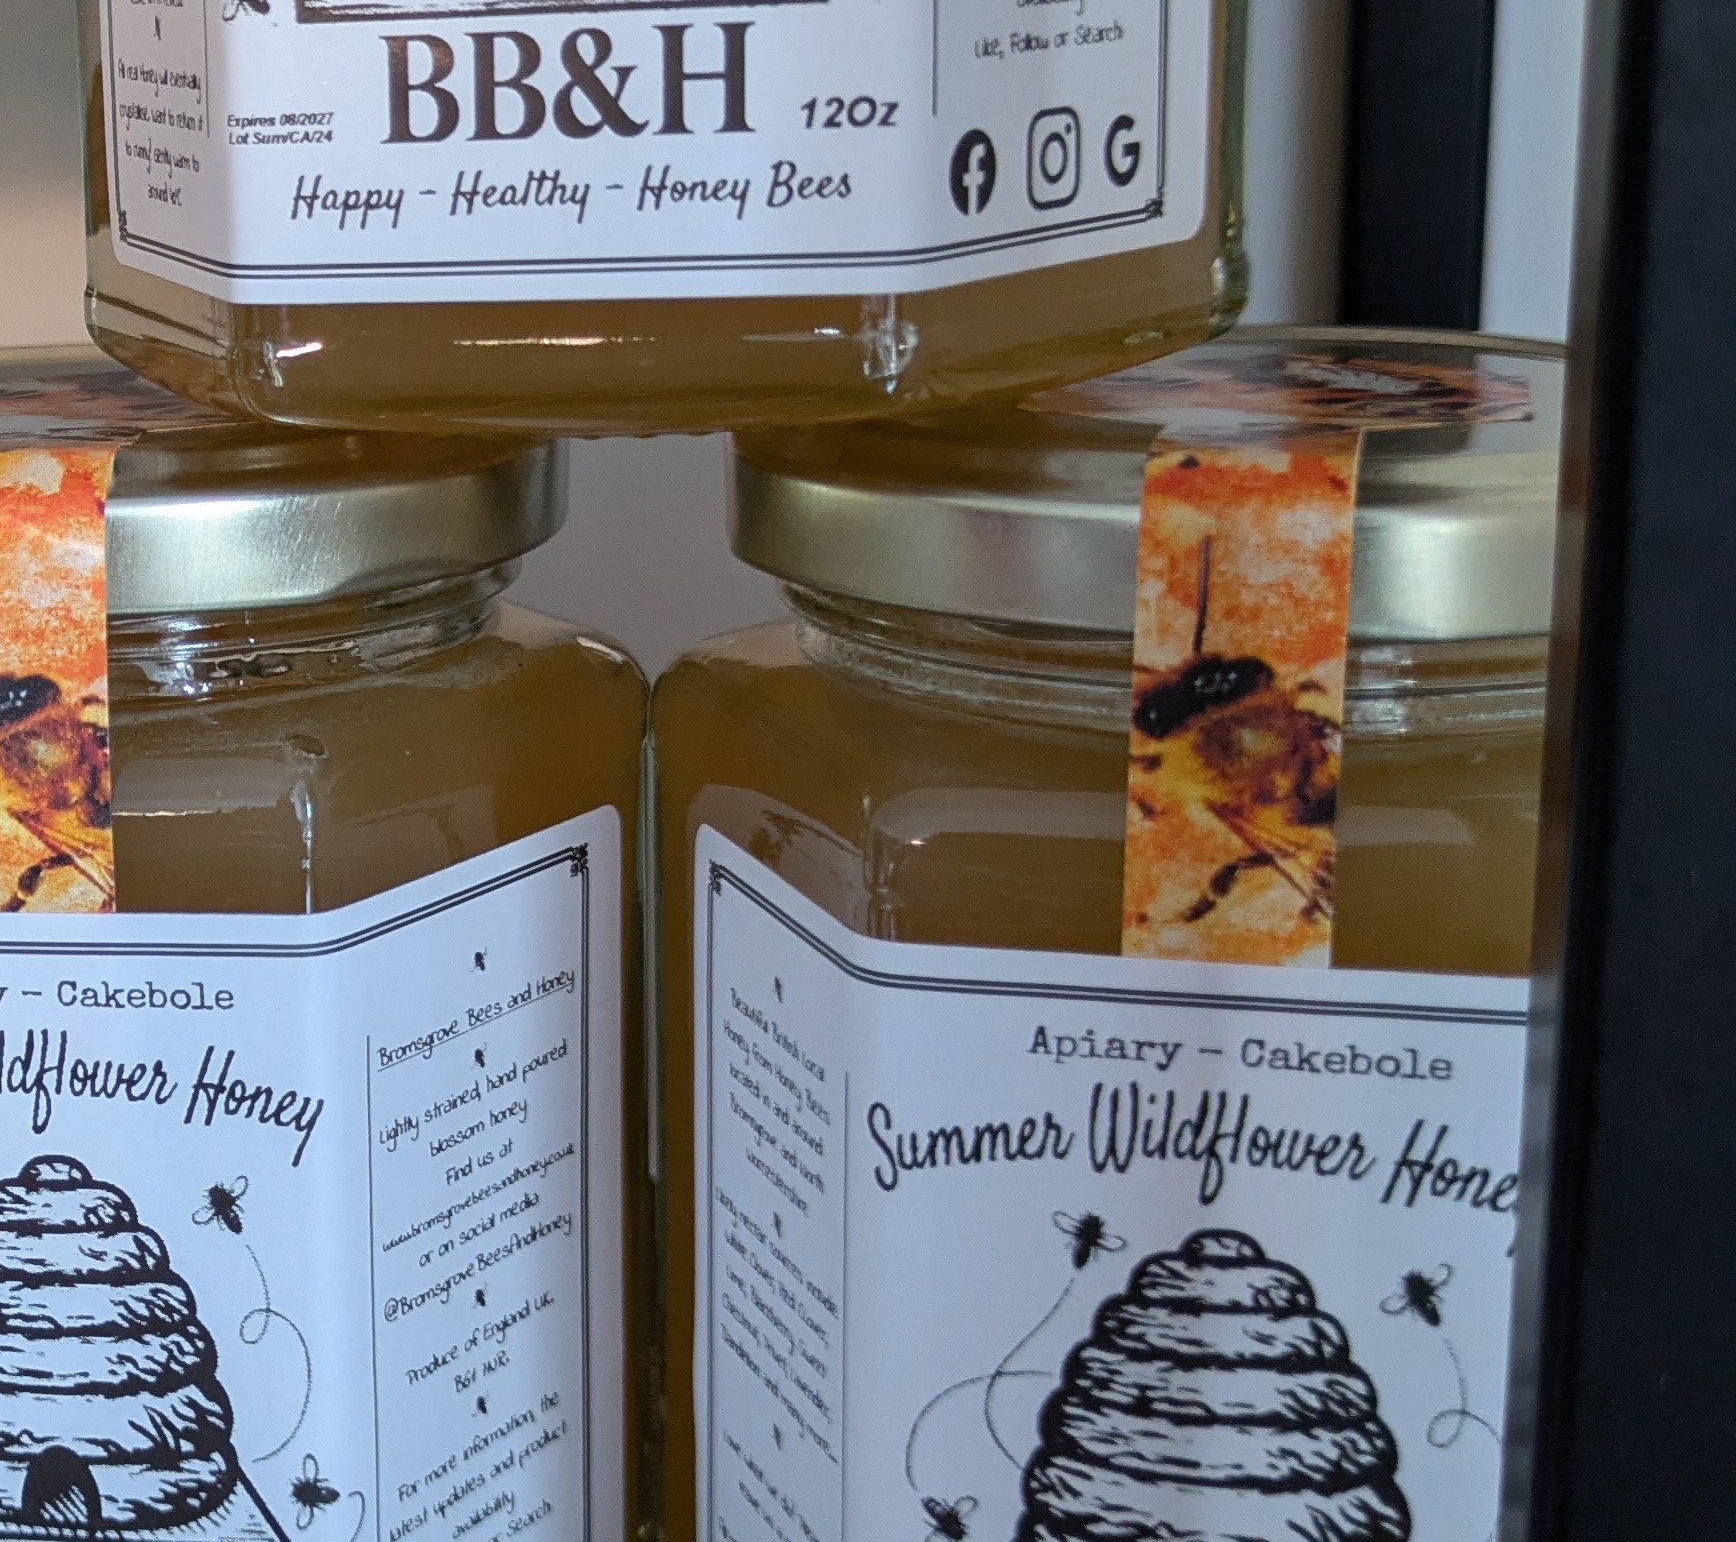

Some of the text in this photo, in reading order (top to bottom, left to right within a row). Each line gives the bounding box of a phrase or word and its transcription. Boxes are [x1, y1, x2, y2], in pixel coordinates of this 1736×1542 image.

[1009, 32, 1050, 53] Follow
[1054, 31, 1069, 48] or
[1074, 19, 1124, 46] Search
[378, 21, 756, 144] BB&H
[227, 111, 334, 130] Expires 08/2027
[228, 132, 249, 145] Lot
[290, 173, 405, 231] Happy
[449, 170, 589, 224] Healthy
[636, 164, 751, 219] Honey
[766, 160, 854, 208] Bees
[56, 980, 235, 1010] Cakebole
[377, 969, 575, 1067] Bromsgrove Bees and Honey
[1027, 1024, 1182, 1070] Apiary
[1240, 1038, 1454, 1081] Cakebole
[183, 1045, 325, 1167] Honey
[380, 1116, 419, 1152] Lightly
[486, 1062, 517, 1093] hand
[522, 1038, 567, 1083] poured
[430, 1100, 527, 1157] blossom honey
[445, 1138, 513, 1185] Find us at
[866, 1080, 1518, 1257] Summer Wildflower Hone
[419, 1192, 539, 1268] or on social media
[406, 1345, 457, 1386] Produce
[464, 1327, 479, 1352] of
[483, 1300, 530, 1343] England
[454, 1367, 476, 1393] B61
[397, 1480, 419, 1502] For
[424, 1454, 457, 1486] more
[540, 1391, 559, 1413] the
[390, 1419, 567, 1542] latest updates and product
[452, 1490, 514, 1539] availability
[506, 1499, 552, 1537] Search
